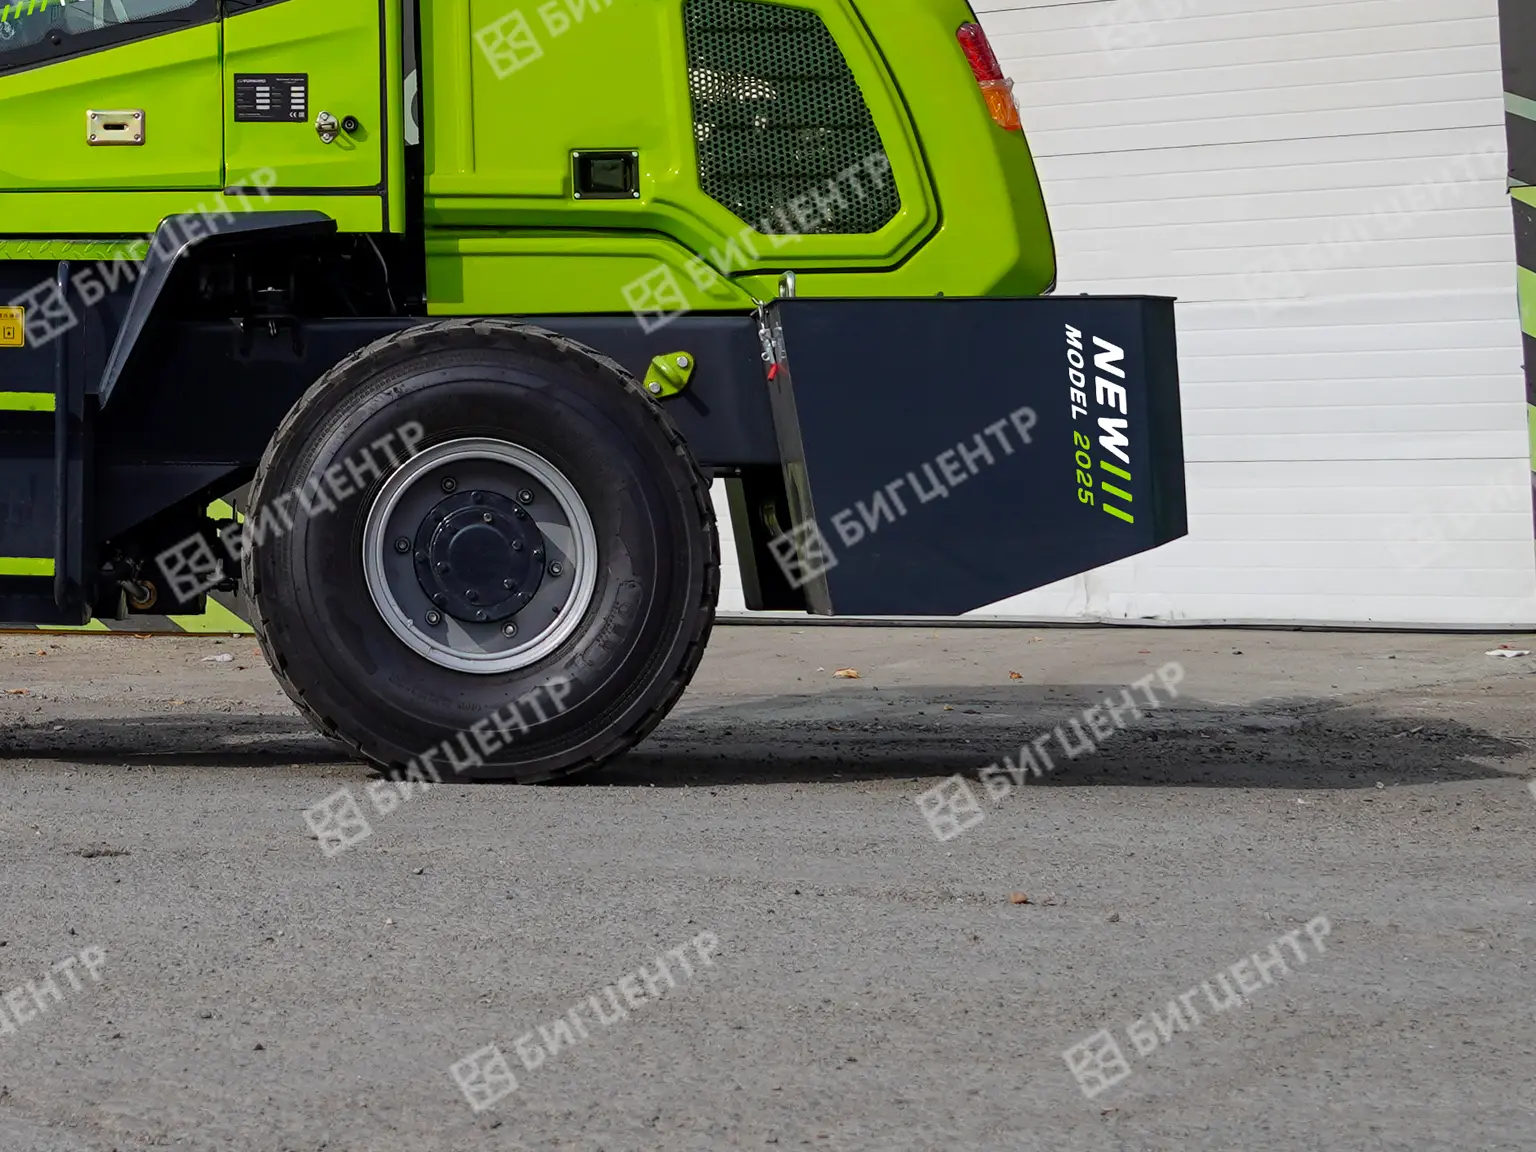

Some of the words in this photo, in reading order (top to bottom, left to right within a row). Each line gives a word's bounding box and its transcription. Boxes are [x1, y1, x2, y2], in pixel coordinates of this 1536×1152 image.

[1064, 323, 1088, 420] MODEL
[1092, 335, 1130, 465] NEW
[1073, 430, 1095, 506] 2025
